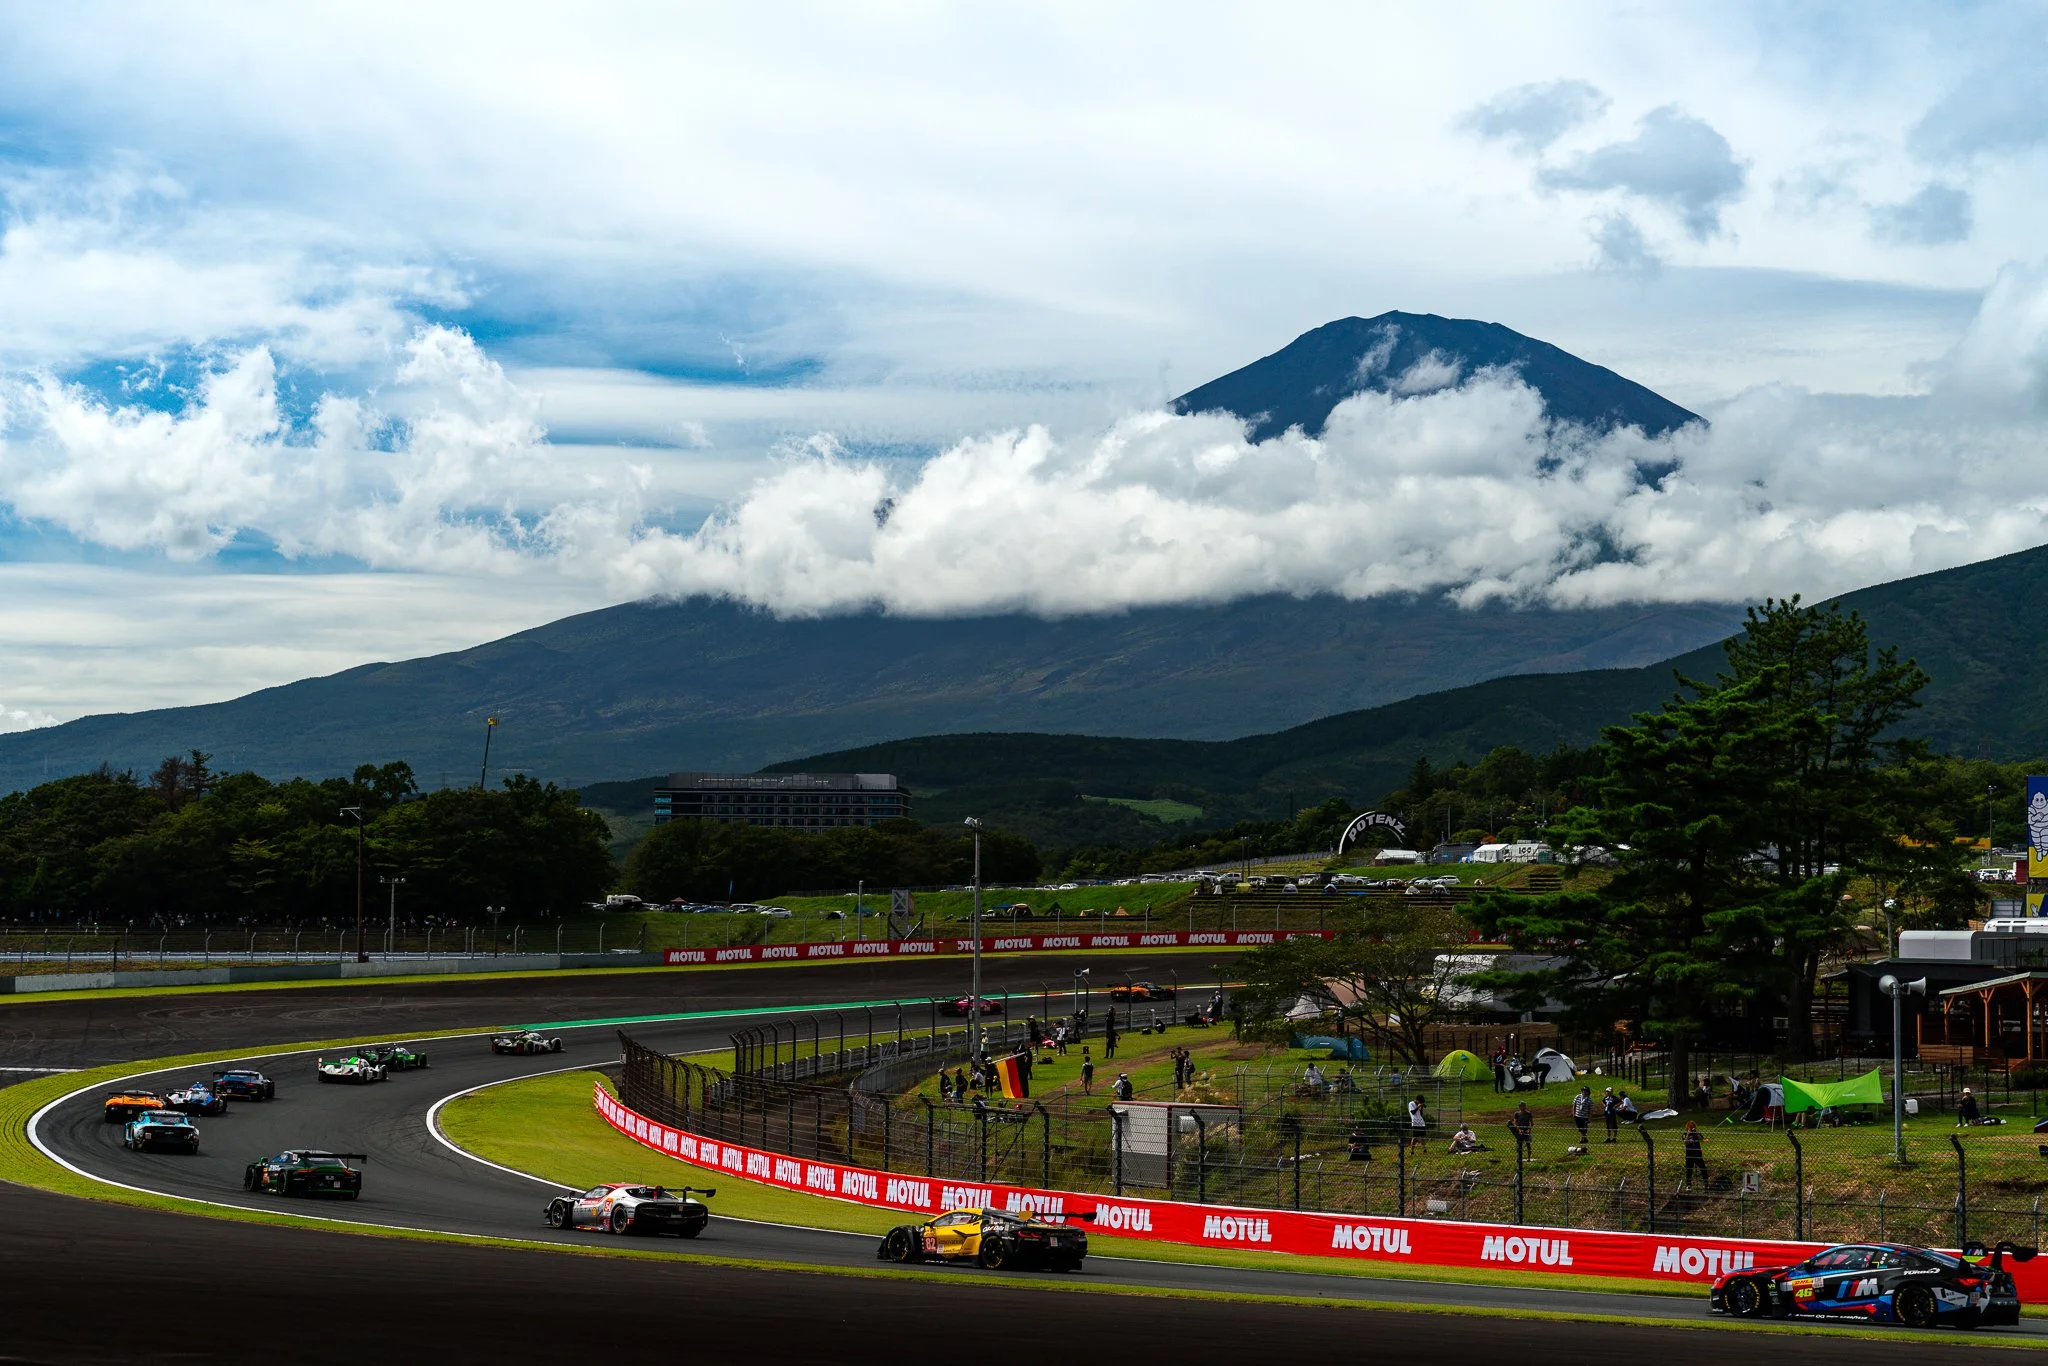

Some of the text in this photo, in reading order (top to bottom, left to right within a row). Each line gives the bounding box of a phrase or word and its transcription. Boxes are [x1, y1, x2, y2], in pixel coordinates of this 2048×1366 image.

[1348, 814, 1406, 842] POTENZ
[669, 951, 706, 963] MOTUL
[716, 949, 752, 961] MOTUL
[762, 947, 798, 958] MOTUL
[808, 945, 844, 956] MOTUL
[853, 943, 889, 954] MOTUL
[899, 942, 935, 953] MOTUL
[994, 939, 1032, 950] MOTUL
[1043, 937, 1080, 948] MOTUL
[1091, 936, 1129, 946] MOTUL
[1140, 934, 1178, 945] MOTUL
[1188, 933, 1226, 944] MOTUL
[700, 1142, 719, 1165] MOTUL
[722, 1147, 743, 1172] MOTUL
[746, 1153, 771, 1179] MOTUL
[775, 1158, 801, 1185] MOTUL
[806, 1165, 836, 1192] MOTUL
[841, 1170, 878, 1200] MOTUL
[885, 1178, 931, 1208] MOTUL
[940, 1186, 994, 1210] MOTUL
[1006, 1192, 1065, 1224] MOTUL
[1094, 1203, 1153, 1232] MOTUL
[1202, 1215, 1272, 1243] MOTUL
[1331, 1224, 1412, 1254] MOTUL
[1480, 1235, 1574, 1266] MOTUL
[925, 1237, 937, 1250] 82
[1795, 1287, 1813, 1298] 46
